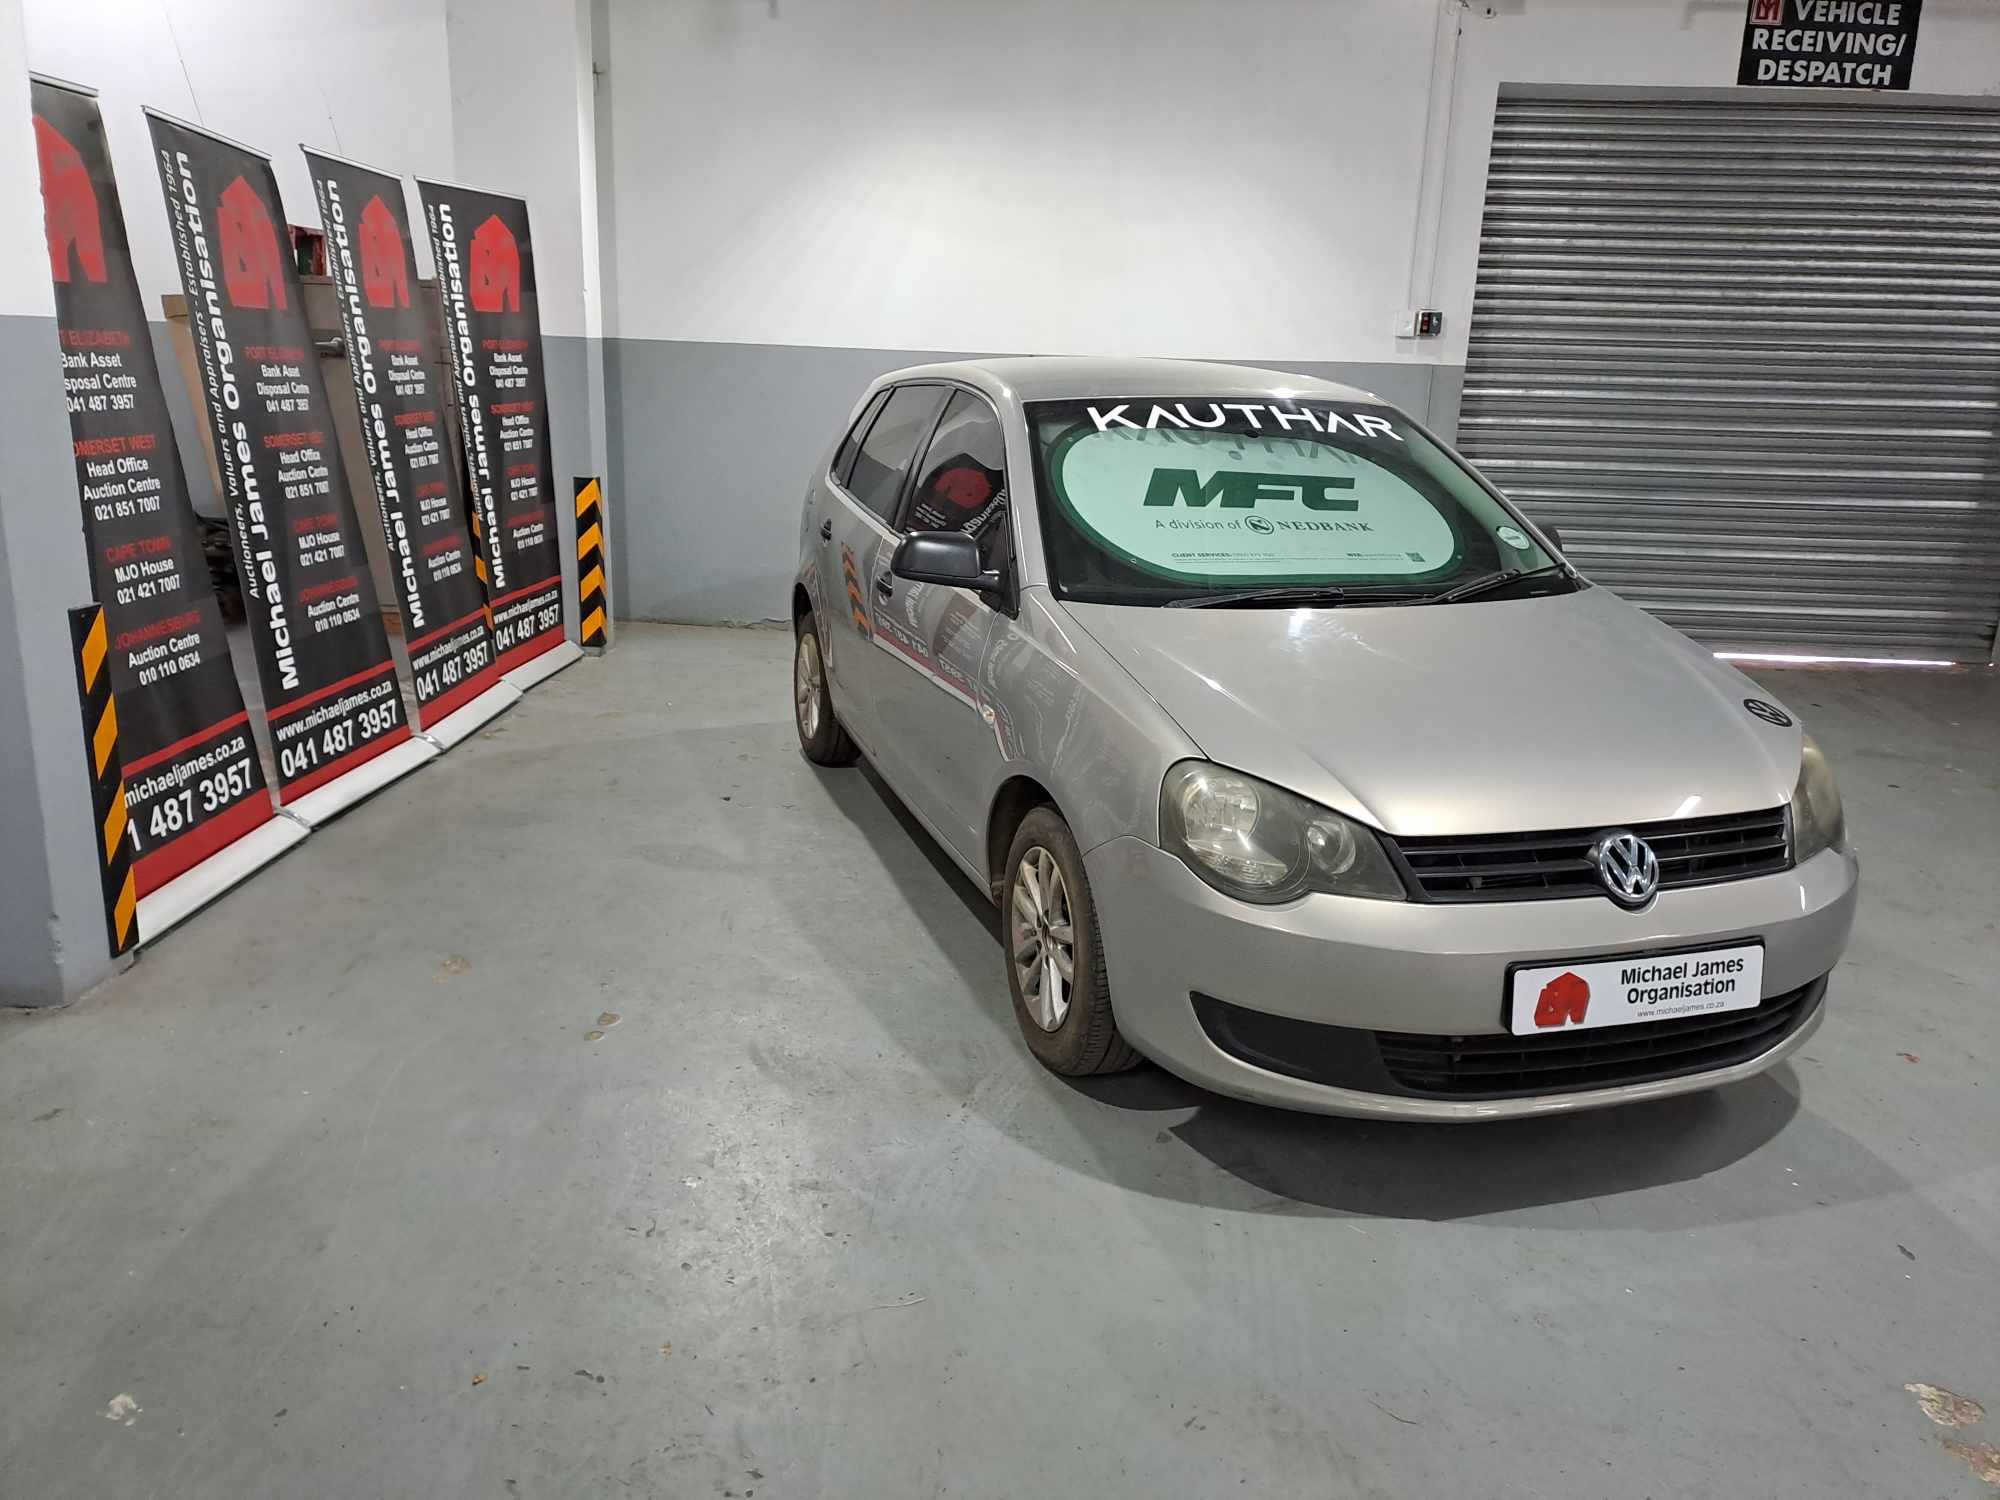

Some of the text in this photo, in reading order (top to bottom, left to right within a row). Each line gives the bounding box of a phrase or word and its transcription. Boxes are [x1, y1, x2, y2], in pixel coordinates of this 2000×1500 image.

[1796, 0, 1902, 25] VEHICLE
[1752, 28, 1907, 56] RECEIVING/
[1757, 59, 1892, 86] DESPATCH
[172, 197, 199, 294] Established
[90, 352, 122, 369] Asset
[197, 312, 220, 397] Appraisers
[103, 373, 137, 389] Centre
[439, 203, 506, 588] Michael James Organisation
[89, 395, 108, 411] 487
[110, 394, 134, 410] 3957
[211, 401, 228, 434] and
[327, 179, 425, 629] Michael James Organisation
[175, 151, 300, 690] Michael James Organisation
[1087, 403, 1403, 441] KAUTHAR
[86, 457, 149, 478] Head Office
[220, 438, 239, 497] Valuers
[84, 477, 161, 501] Auction Centre
[1143, 467, 1360, 512] MFC
[94, 496, 161, 521] 021 851 7007
[1155, 518, 1376, 532] A division of NEDBANK
[114, 558, 174, 583] MJO House
[117, 574, 180, 604] 021 421 7007
[496, 603, 559, 650] 041 487 3957
[128, 633, 200, 668] Auction Centre
[139, 651, 200, 686] 010 110 0634
[416, 640, 488, 700] 041 487 3957
[276, 680, 393, 742] www.michaeljames.co.za
[280, 698, 398, 778] 041 487 3957
[150, 789, 194, 837] 487
[199, 757, 252, 811] 3957
[1620, 958, 1744, 985] Michael James
[1626, 979, 1736, 1005] Organisation
[1637, 1001, 1725, 1018] www.michaeljames.co.za
